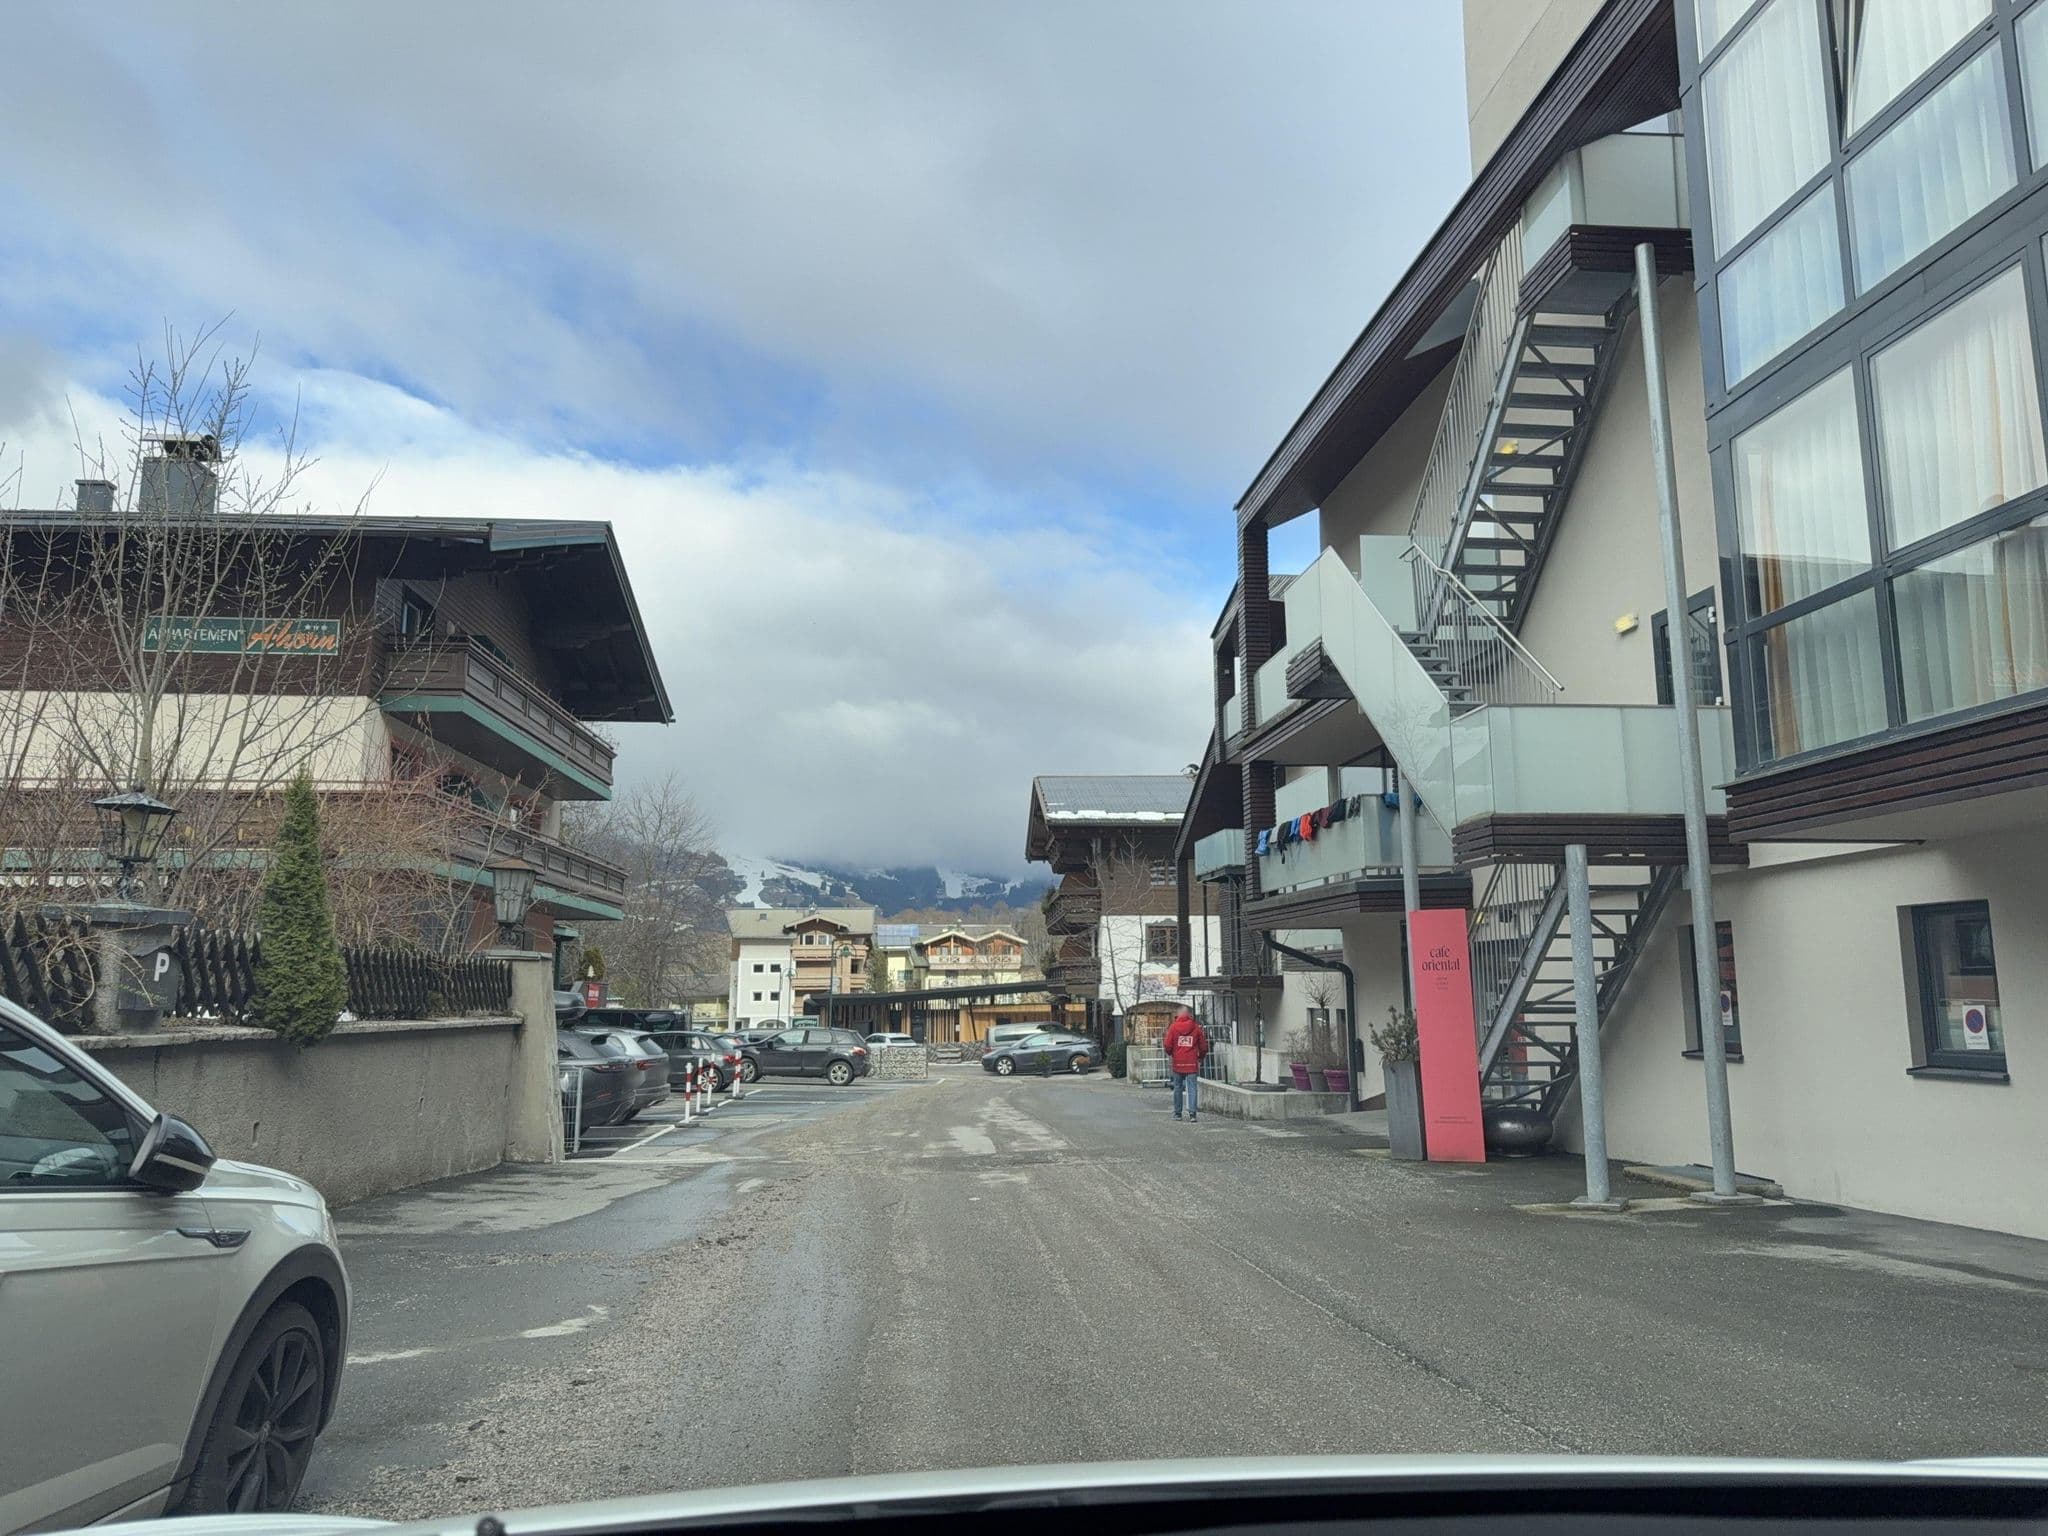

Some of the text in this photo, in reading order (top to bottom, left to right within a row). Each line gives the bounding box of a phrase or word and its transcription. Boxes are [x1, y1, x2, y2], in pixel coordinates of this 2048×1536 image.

[147, 627, 246, 642] APARTEMENT
[154, 952, 170, 982] P
[1421, 958, 1460, 971] oriental
